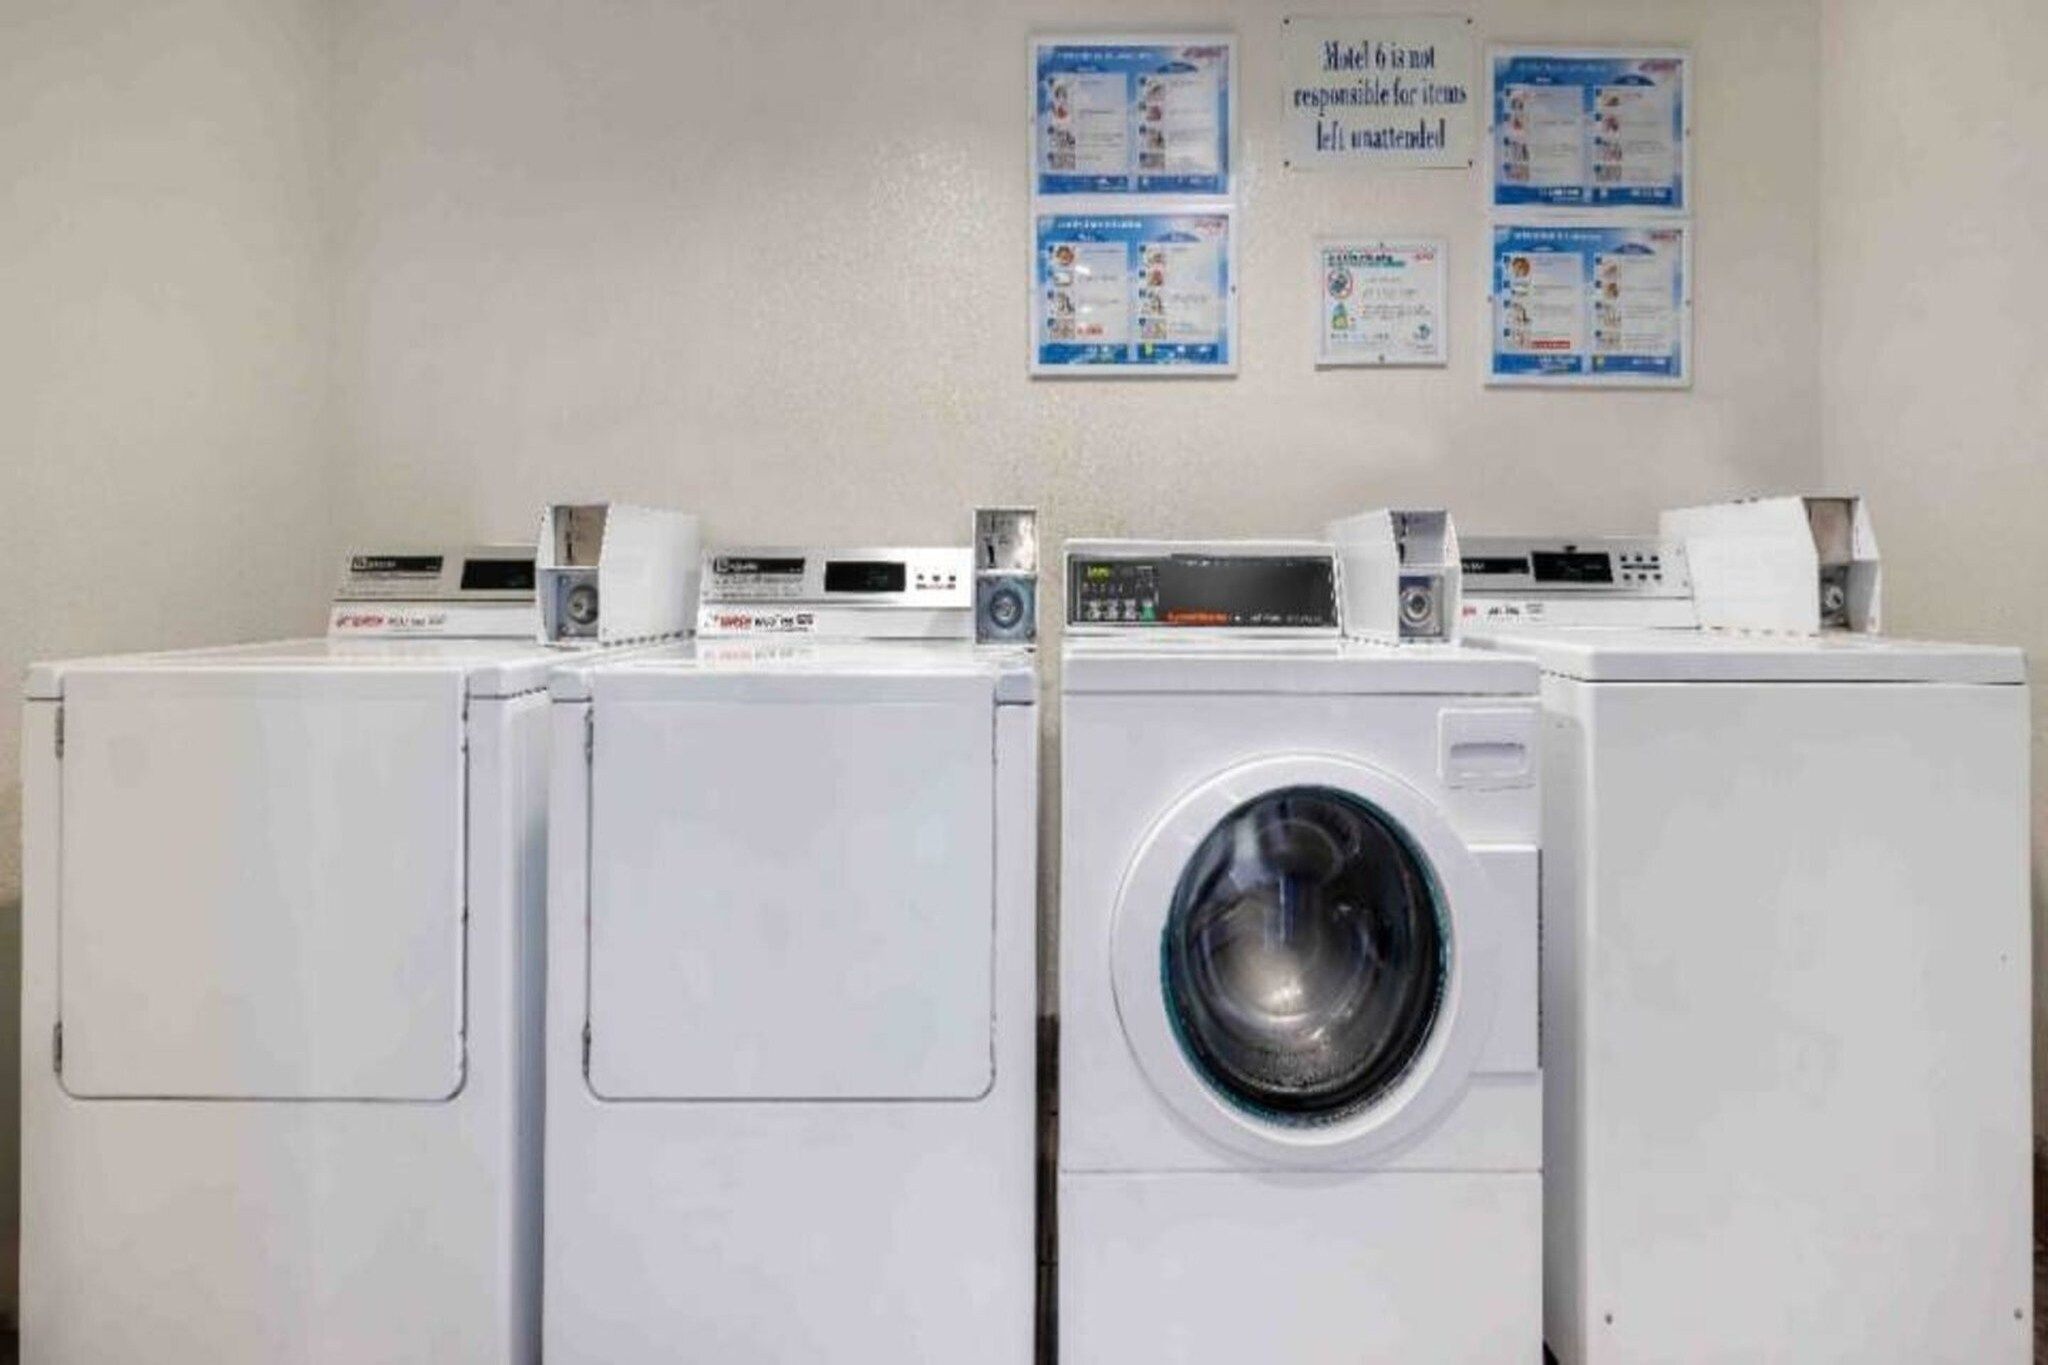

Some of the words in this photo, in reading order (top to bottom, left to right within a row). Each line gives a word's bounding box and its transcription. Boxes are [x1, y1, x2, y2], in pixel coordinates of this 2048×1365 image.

[1322, 40, 1369, 70] Motel
[1375, 42, 1386, 70] 6
[1391, 42, 1405, 69] is
[1408, 45, 1435, 69] not
[1294, 76, 1390, 117] responsible
[1393, 76, 1418, 106] for
[1422, 78, 1467, 105] items
[1316, 120, 1345, 151] left
[1351, 118, 1446, 150] unattended
